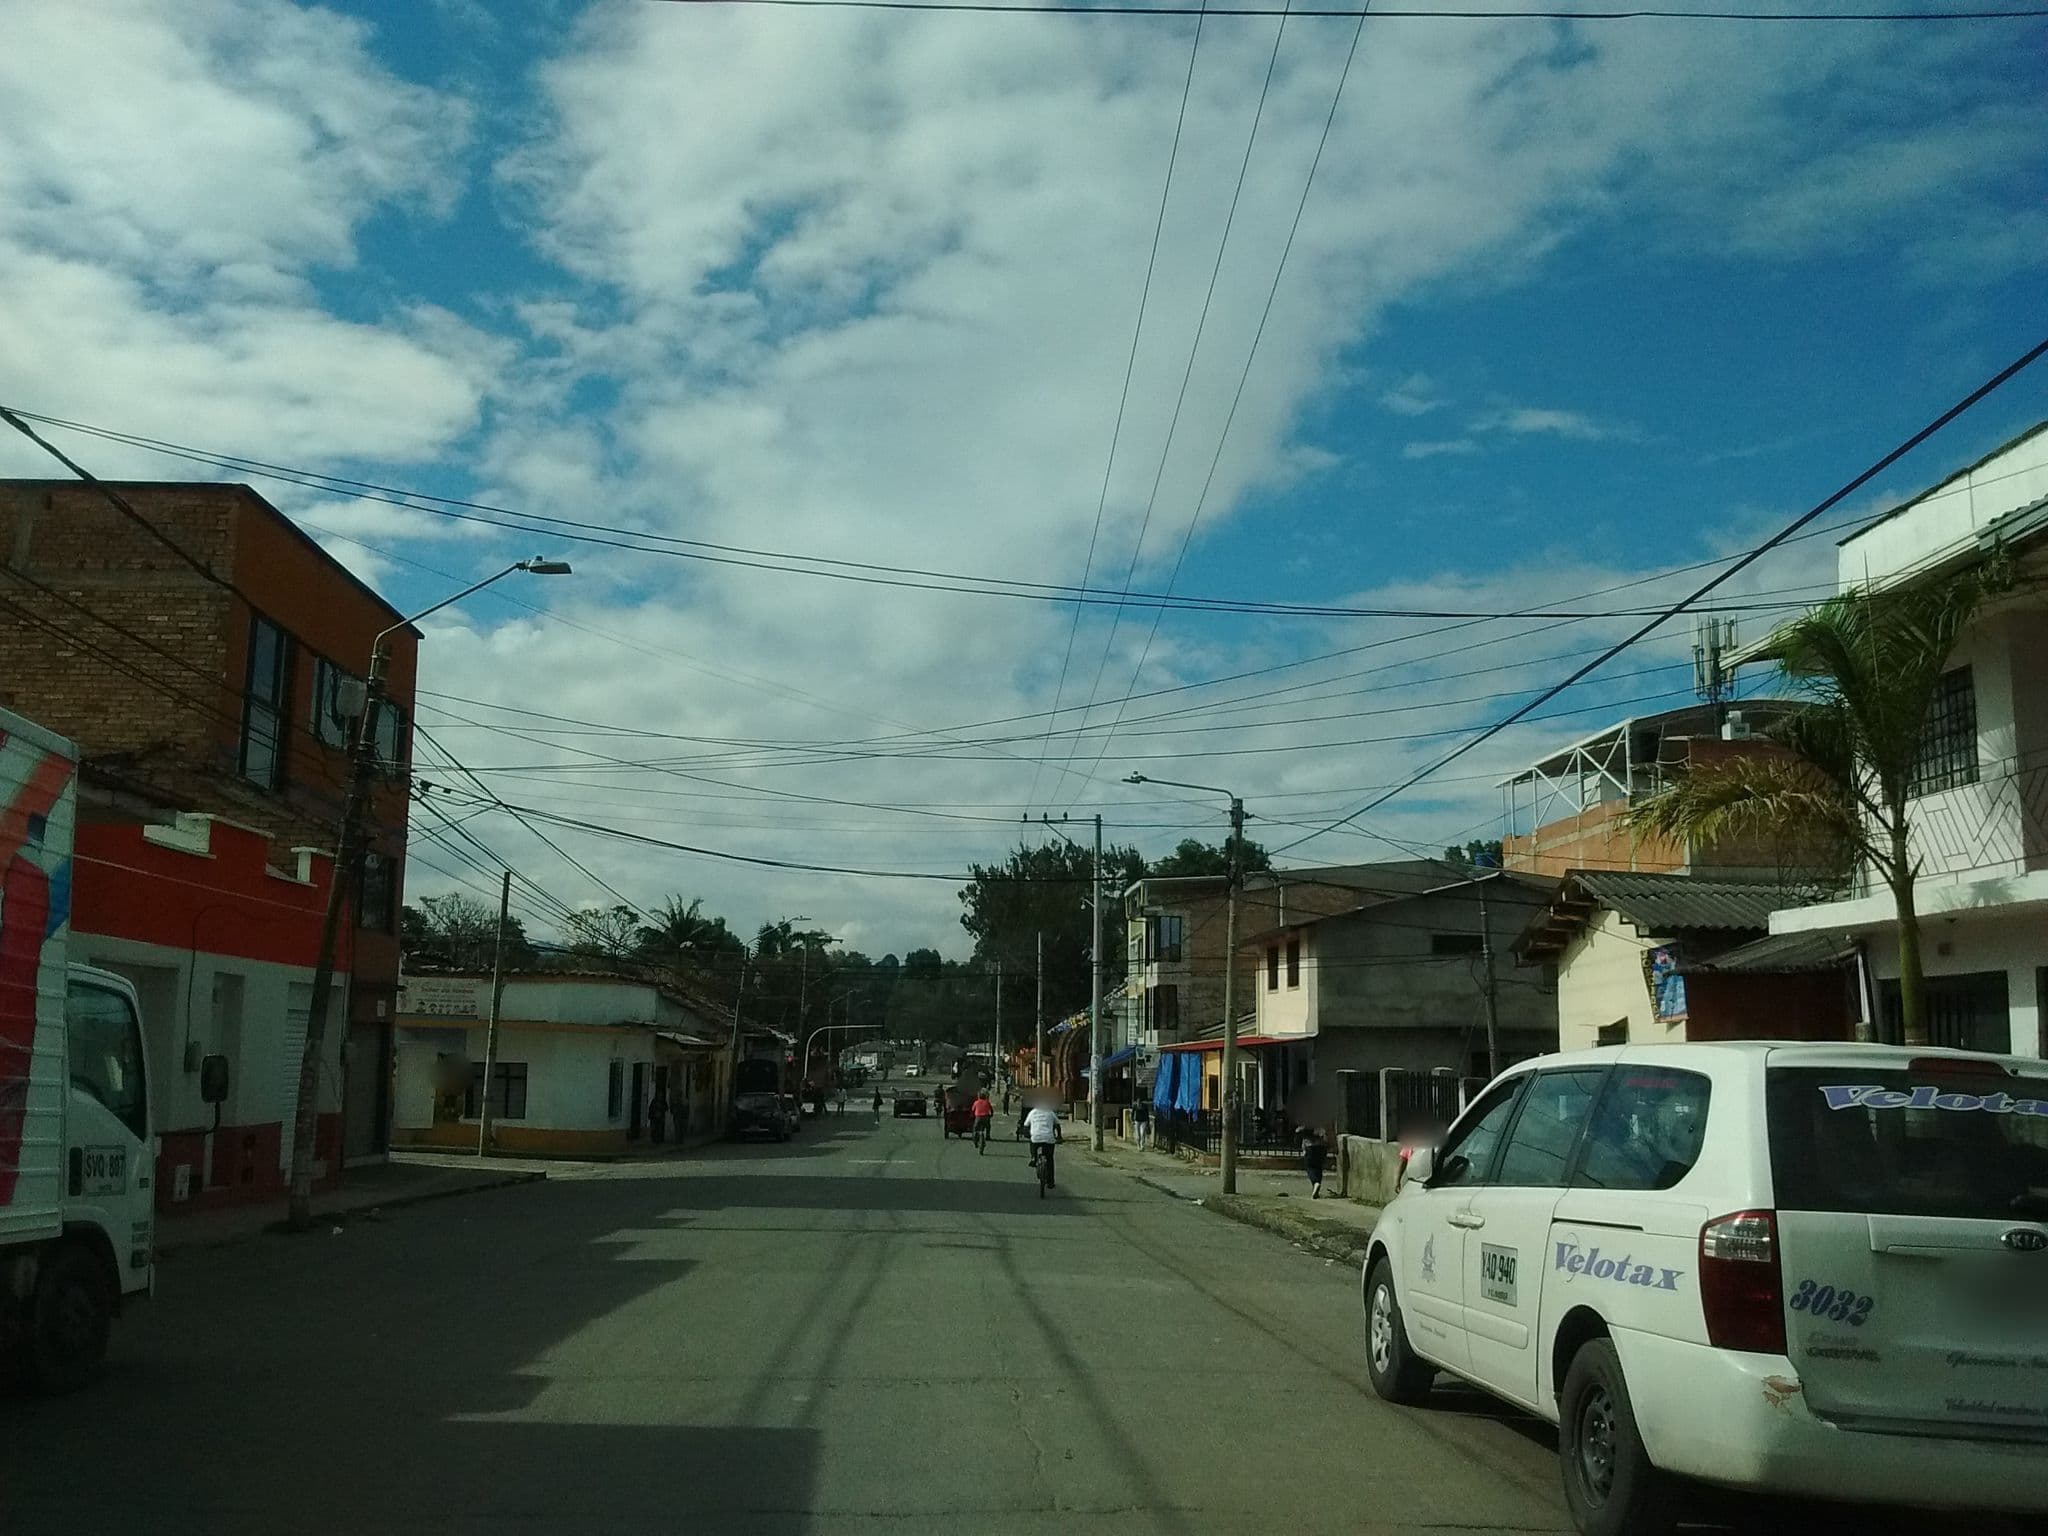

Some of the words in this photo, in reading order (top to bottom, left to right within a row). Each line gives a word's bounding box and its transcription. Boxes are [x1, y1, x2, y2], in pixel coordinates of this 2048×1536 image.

[2010, 1233, 2045, 1249] KIA
[1498, 1254, 1516, 1285] 940
[1554, 1240, 1685, 1291] Velotax
[1790, 1279, 1874, 1327] 3032
